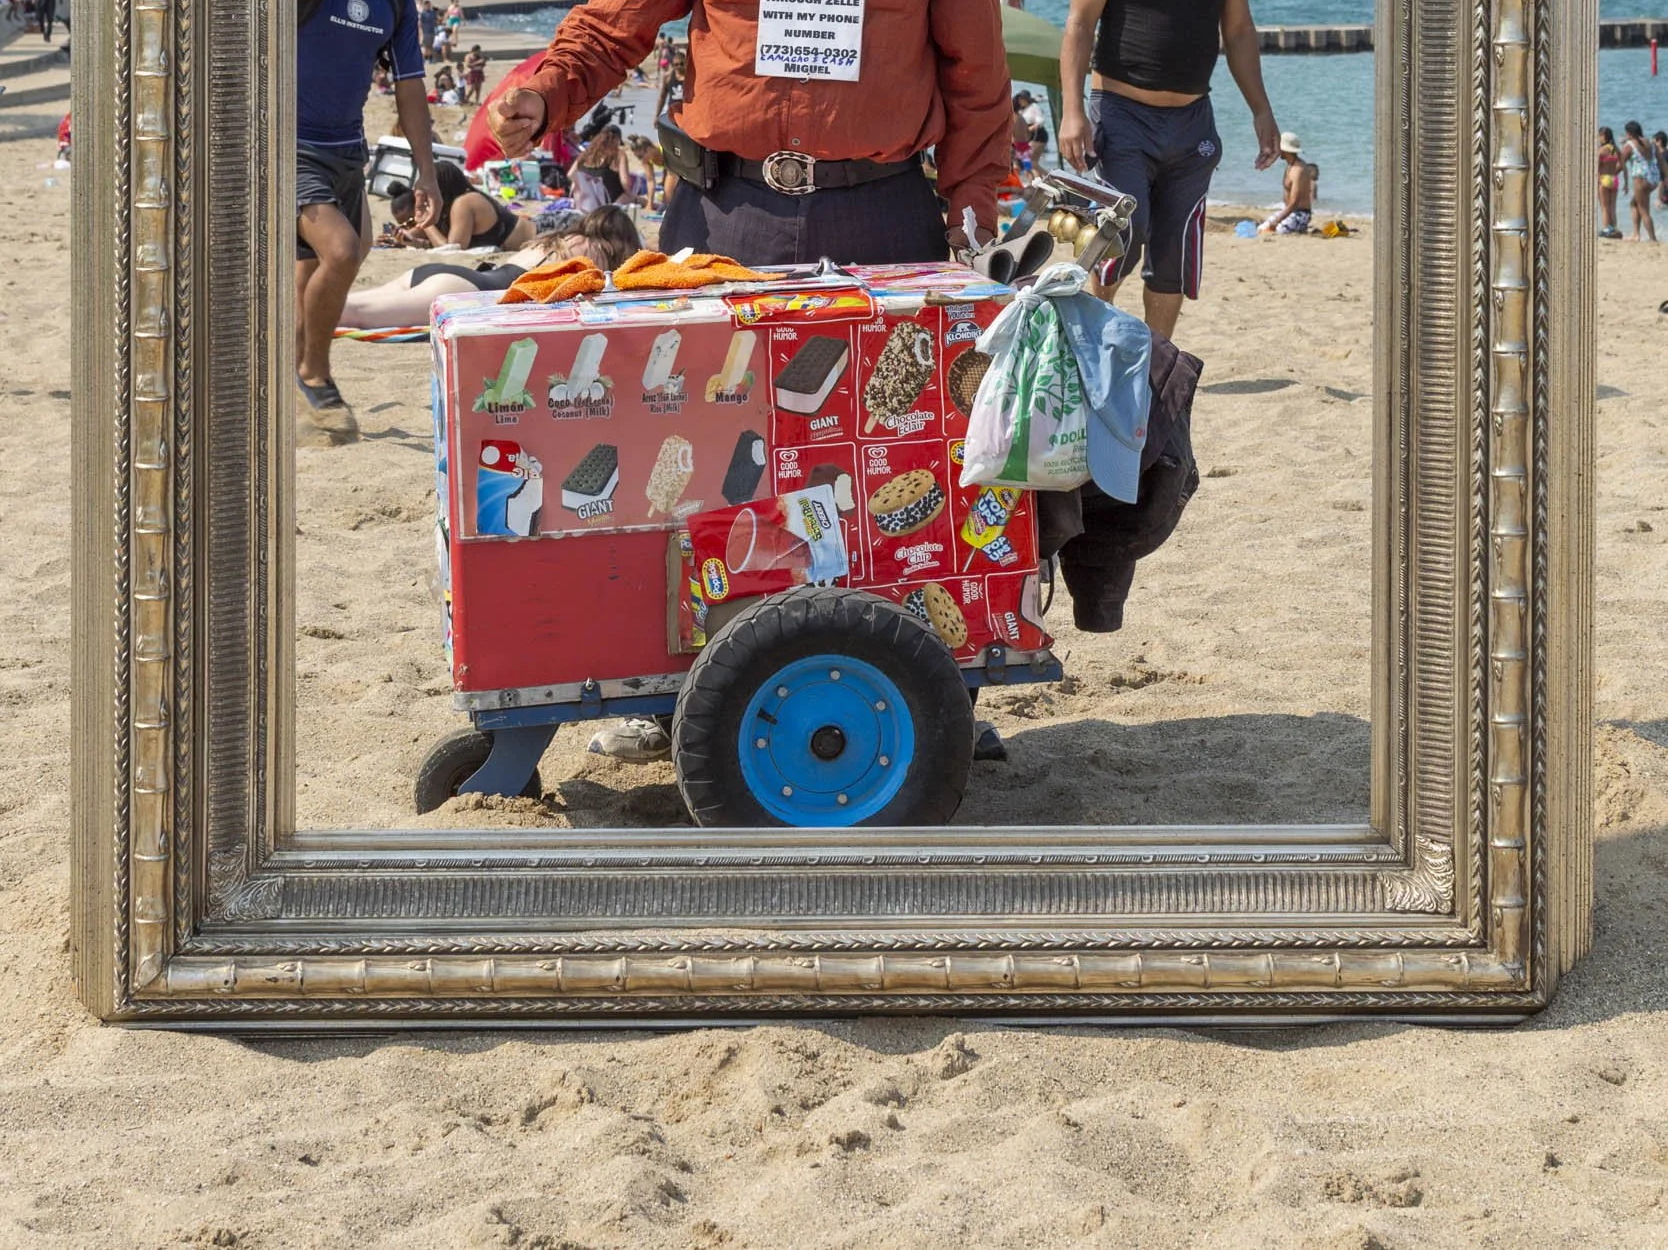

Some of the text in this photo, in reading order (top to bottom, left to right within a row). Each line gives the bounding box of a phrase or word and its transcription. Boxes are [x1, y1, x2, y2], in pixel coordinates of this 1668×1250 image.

[763, 10, 860, 24] WITH MY PHONE
[784, 29, 836, 40] NUMBER
[784, 63, 831, 74] MIGUEL
[861, 324, 887, 333] HUMOR
[773, 332, 798, 341] HUMOR
[715, 392, 748, 404] Mango
[495, 415, 518, 424] Lime
[809, 415, 839, 430] GIANT
[885, 410, 935, 430] Chocolate
[780, 461, 798, 470] GOOD
[869, 458, 888, 467] GOOD
[778, 469, 802, 478] HUMOR
[866, 466, 892, 475] HUMOR
[577, 498, 615, 519] GIANT
[895, 542, 943, 560] Chocolate
[908, 552, 931, 565] Chip
[961, 579, 971, 605] HUMOR
[1004, 612, 1020, 641] GIANT
